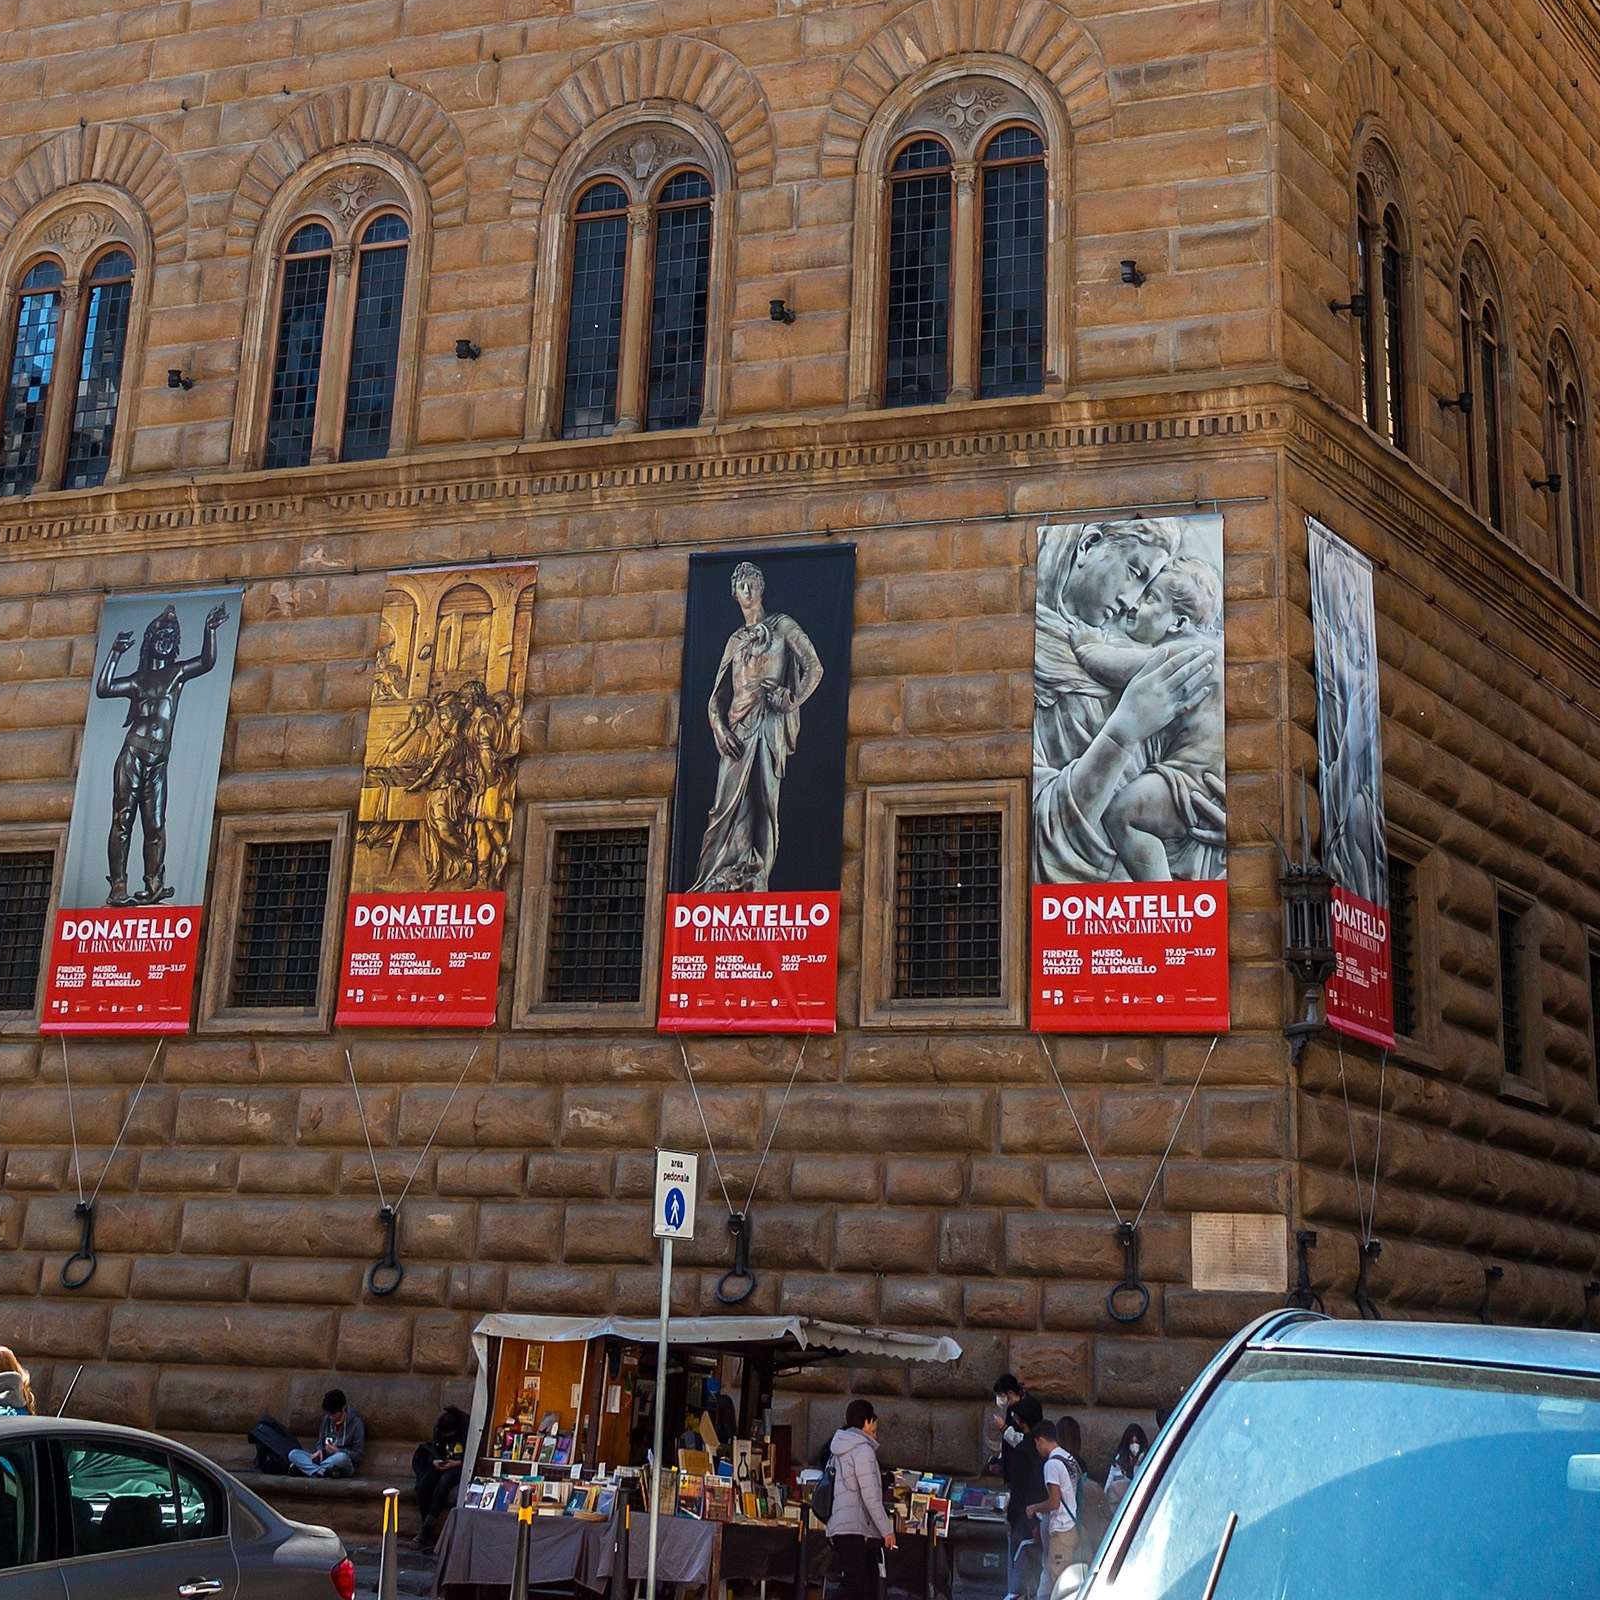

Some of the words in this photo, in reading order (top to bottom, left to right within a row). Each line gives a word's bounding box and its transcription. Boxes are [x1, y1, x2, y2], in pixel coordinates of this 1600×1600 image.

[1043, 894, 1216, 920] DONATELLO
[355, 903, 497, 926] DONATELLO
[675, 904, 831, 927] DONATELLO
[1332, 900, 1386, 942] ONATELLO
[62, 919, 194, 940] DONATELLO
[1067, 920, 1080, 935] IL
[1085, 919, 1192, 935] RINASCIMENTO
[373, 926, 385, 940] IL
[387, 926, 474, 940] RINASCIMENTO
[695, 927, 708, 942] IL
[711, 927, 807, 942] RINASCIMENTO
[78, 940, 90, 953] IL
[92, 940, 173, 953] RINASCIMENTO
[1092, 949, 1122, 957] MUSEO
[716, 955, 743, 963] MUSEO
[1043, 958, 1083, 966] PALAZZO
[1092, 957, 1142, 966] NAZIONALE
[1166, 957, 1185, 965] 2022
[404, 967, 442, 975] BARGELLO
[716, 963, 761, 971] NAZIONALE
[781, 963, 799, 971] 2022
[1043, 967, 1080, 975] STROZZI
[1092, 966, 1108, 974] DEL
[1110, 965, 1156, 974] BARGELLO
[715, 971, 730, 979] DEL
[731, 971, 773, 979] BARGELLO
[671, 1160, 683, 1168] area
[664, 1172, 689, 1182] pedonale
